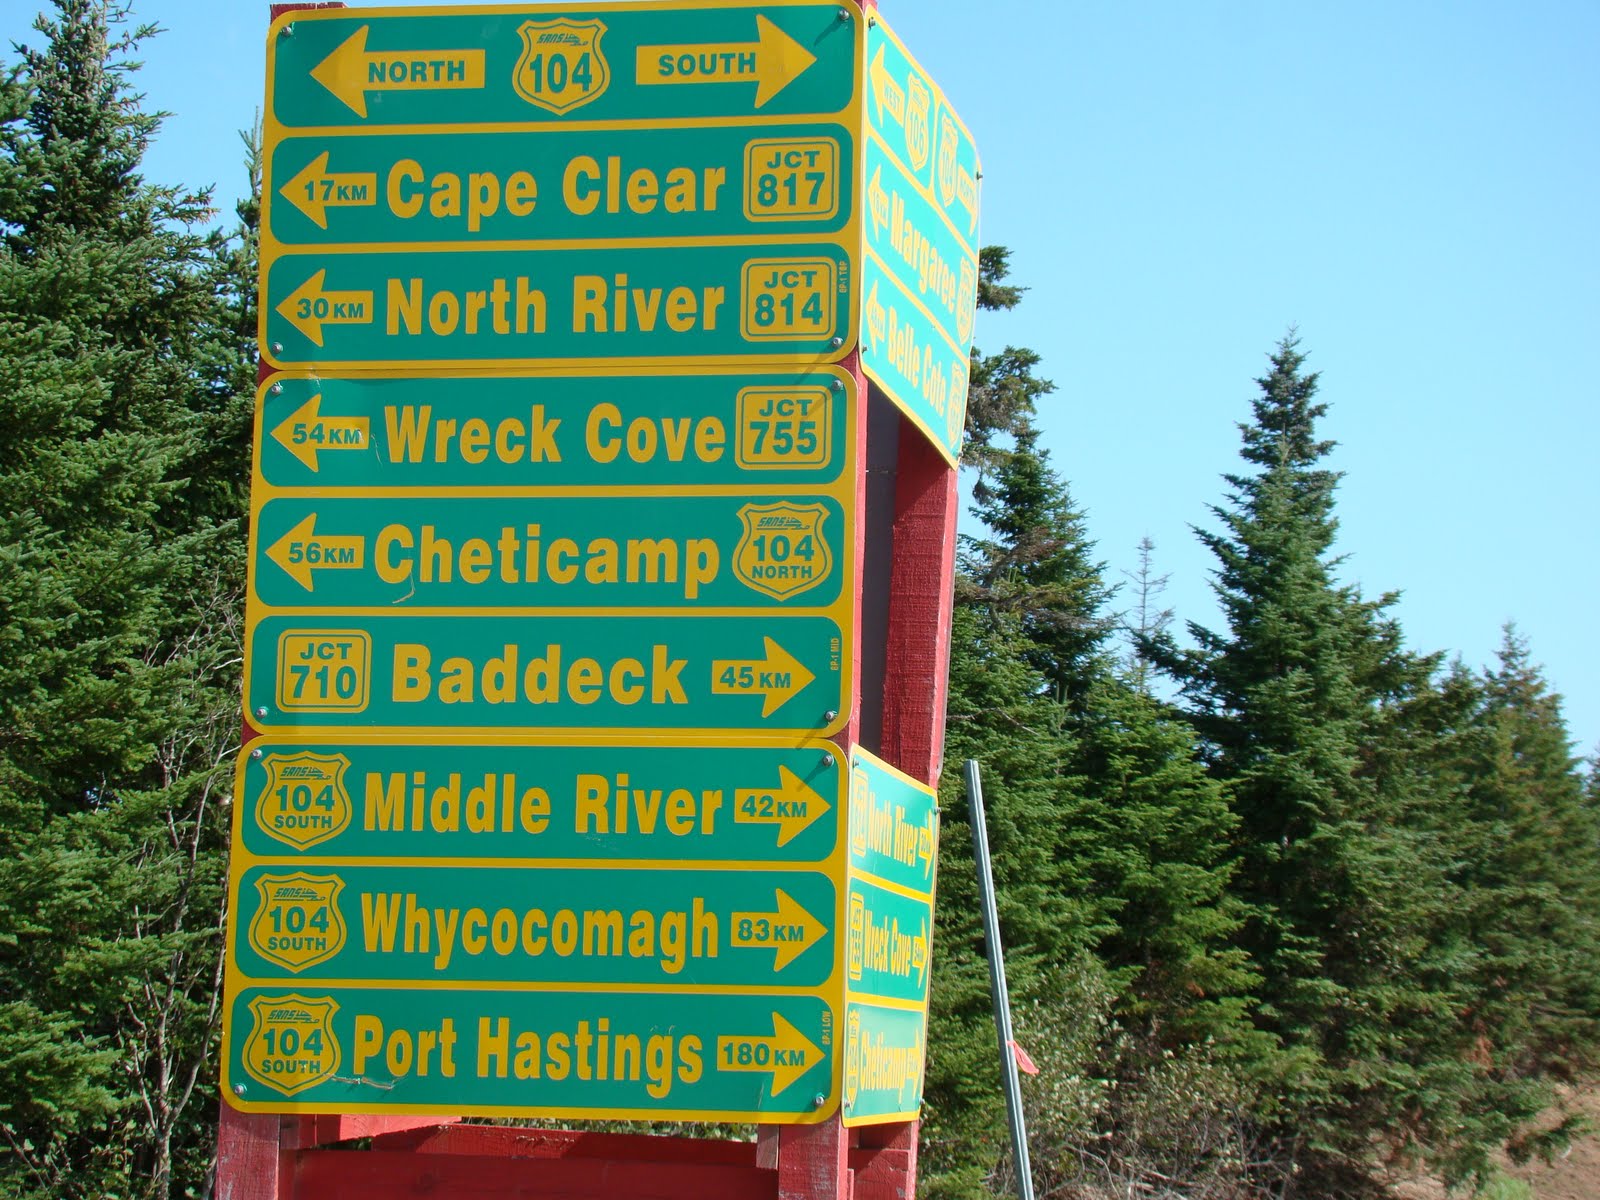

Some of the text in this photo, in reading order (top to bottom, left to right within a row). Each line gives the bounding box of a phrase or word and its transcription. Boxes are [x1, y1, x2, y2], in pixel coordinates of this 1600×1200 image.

[536, 33, 564, 43] SANS
[368, 60, 465, 83] NORTH
[529, 52, 592, 94] 104
[658, 52, 756, 77] SOUTH
[766, 150, 821, 169] JCT
[386, 155, 726, 232] Cape Clear
[757, 172, 826, 207] 817
[890, 190, 956, 314] Margaree
[764, 270, 818, 289] JCT
[386, 273, 725, 336] North River
[754, 292, 823, 327] 814
[888, 305, 921, 389] Belle
[758, 399, 813, 417] JCT
[384, 402, 726, 464] Wreck Cove
[750, 421, 817, 455] 755
[756, 516, 785, 527] SANS
[374, 523, 720, 599] Cheticamp
[752, 535, 815, 562] 104
[751, 565, 812, 579] NORTH
[300, 642, 352, 660] JCT
[290, 665, 357, 699] 710
[392, 643, 689, 705] Baddeck
[280, 766, 308, 777] SANS
[275, 784, 336, 812] 104
[363, 771, 723, 836] Middle River
[273, 815, 332, 829] SOUTH
[868, 791, 893, 858] North
[893, 805, 919, 867] River
[273, 887, 301, 898] SANS
[268, 906, 330, 934] 104
[361, 893, 719, 975] Whycocomagh
[268, 937, 327, 951] SOUTH
[864, 908, 912, 978] Wreck Cove
[268, 1009, 296, 1020] SANS
[262, 1028, 324, 1057] 104
[353, 1014, 704, 1099] Port Hastings
[261, 1059, 321, 1074] SOUTH
